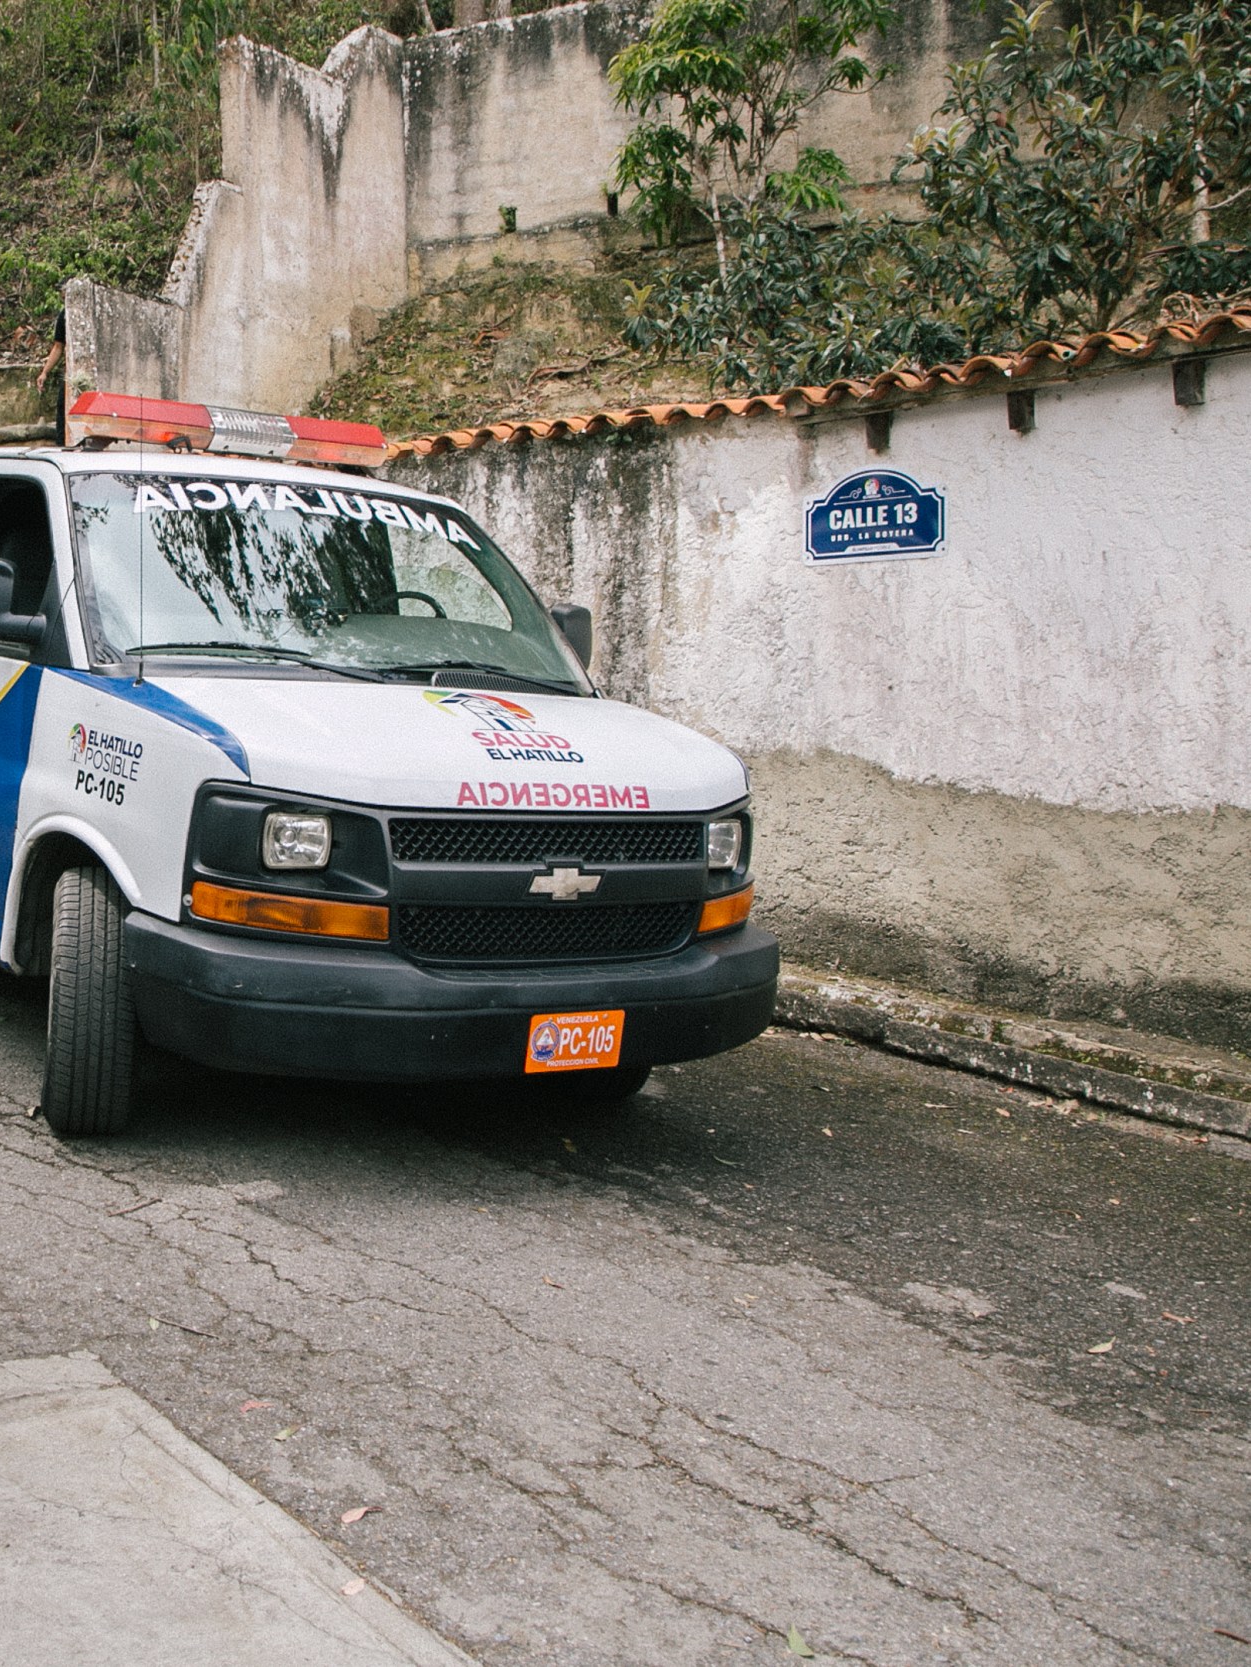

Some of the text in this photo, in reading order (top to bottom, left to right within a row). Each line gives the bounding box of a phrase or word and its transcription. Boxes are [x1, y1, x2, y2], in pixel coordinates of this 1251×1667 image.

[829, 502, 918, 530] CALLE 13
[858, 532, 870, 540] LA
[88, 729, 143, 759] EL HATILLO
[471, 731, 572, 749] SALUD
[84, 747, 140, 782] POSIBLE
[486, 748, 584, 763] EL HATILLO
[75, 769, 126, 806] PC-105
[556, 1015, 599, 1025] VENEZUELA
[558, 1025, 616, 1056] PC-105
